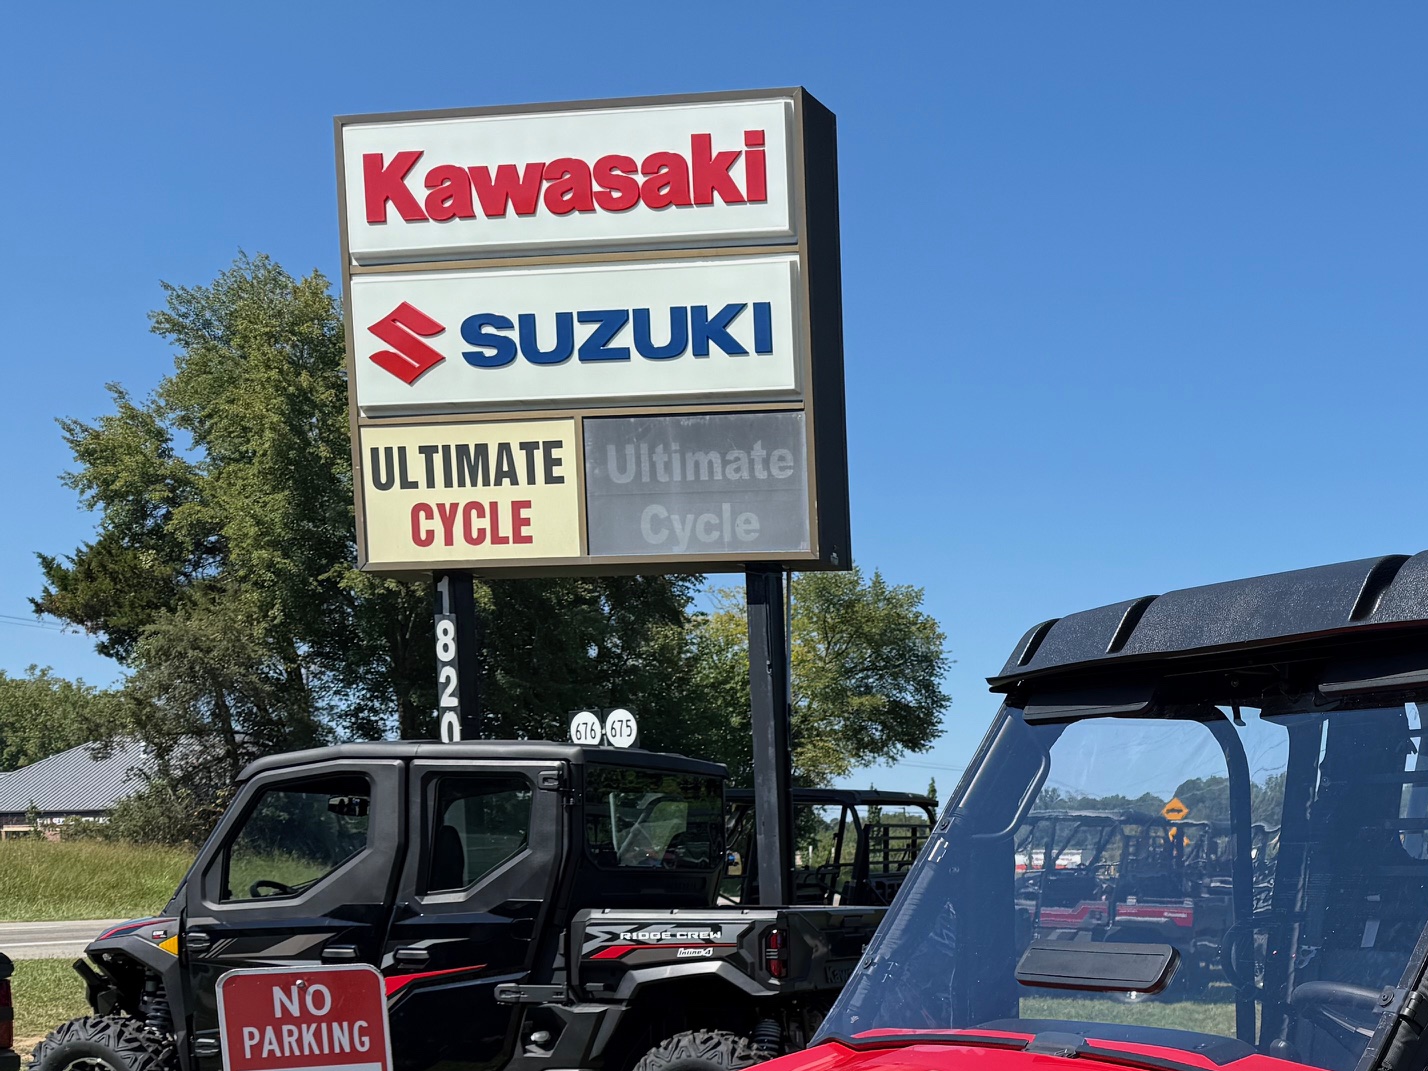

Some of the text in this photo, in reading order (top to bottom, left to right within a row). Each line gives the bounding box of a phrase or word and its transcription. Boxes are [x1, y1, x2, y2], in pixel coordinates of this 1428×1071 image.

[362, 129, 768, 225] Kawasaki
[460, 301, 773, 368] SUZUKI
[369, 439, 566, 491] ULTIMATE
[604, 439, 796, 485] Ultimate
[410, 499, 534, 548] CYCLE
[639, 502, 761, 551] Cycle
[436, 575, 462, 743] 1820
[575, 722, 597, 741] 676
[610, 719, 634, 738] 675
[620, 931, 722, 940] RIDGE CREW
[272, 984, 332, 1018] NO
[242, 1020, 371, 1059] PARKING
